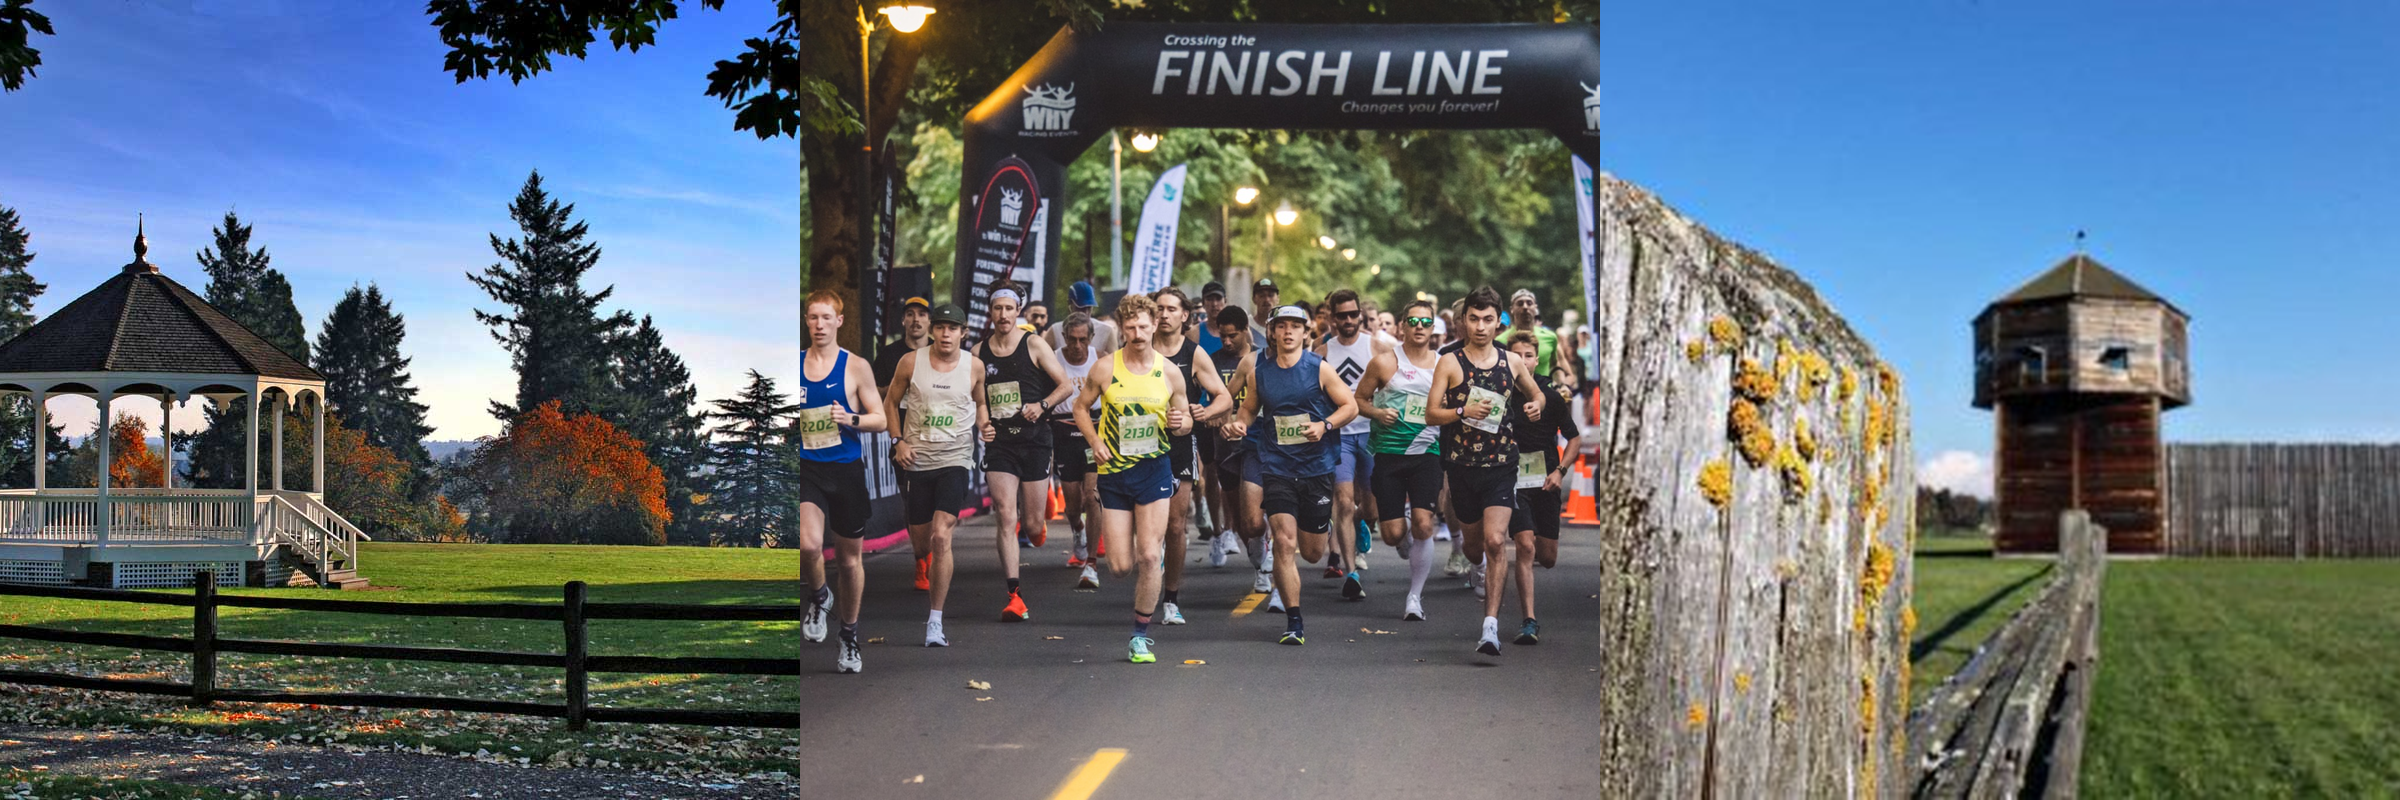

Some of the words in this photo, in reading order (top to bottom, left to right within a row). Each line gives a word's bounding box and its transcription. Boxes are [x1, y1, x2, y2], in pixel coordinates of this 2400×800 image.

[1164, 34, 1227, 48] Crossing
[1231, 35, 1256, 46] the
[1152, 51, 1352, 96] FINISH
[1371, 50, 1509, 95] LINE
[1341, 101, 1404, 114] Changes
[1408, 104, 1435, 115] you
[1437, 99, 1500, 115] forever!
[1023, 106, 1076, 130] WHY
[990, 392, 1019, 405] 2009
[1115, 396, 1161, 404] CONNECTICUT
[802, 418, 834, 433] 2202
[923, 415, 954, 427] 2180
[1123, 426, 1155, 439] 2130
